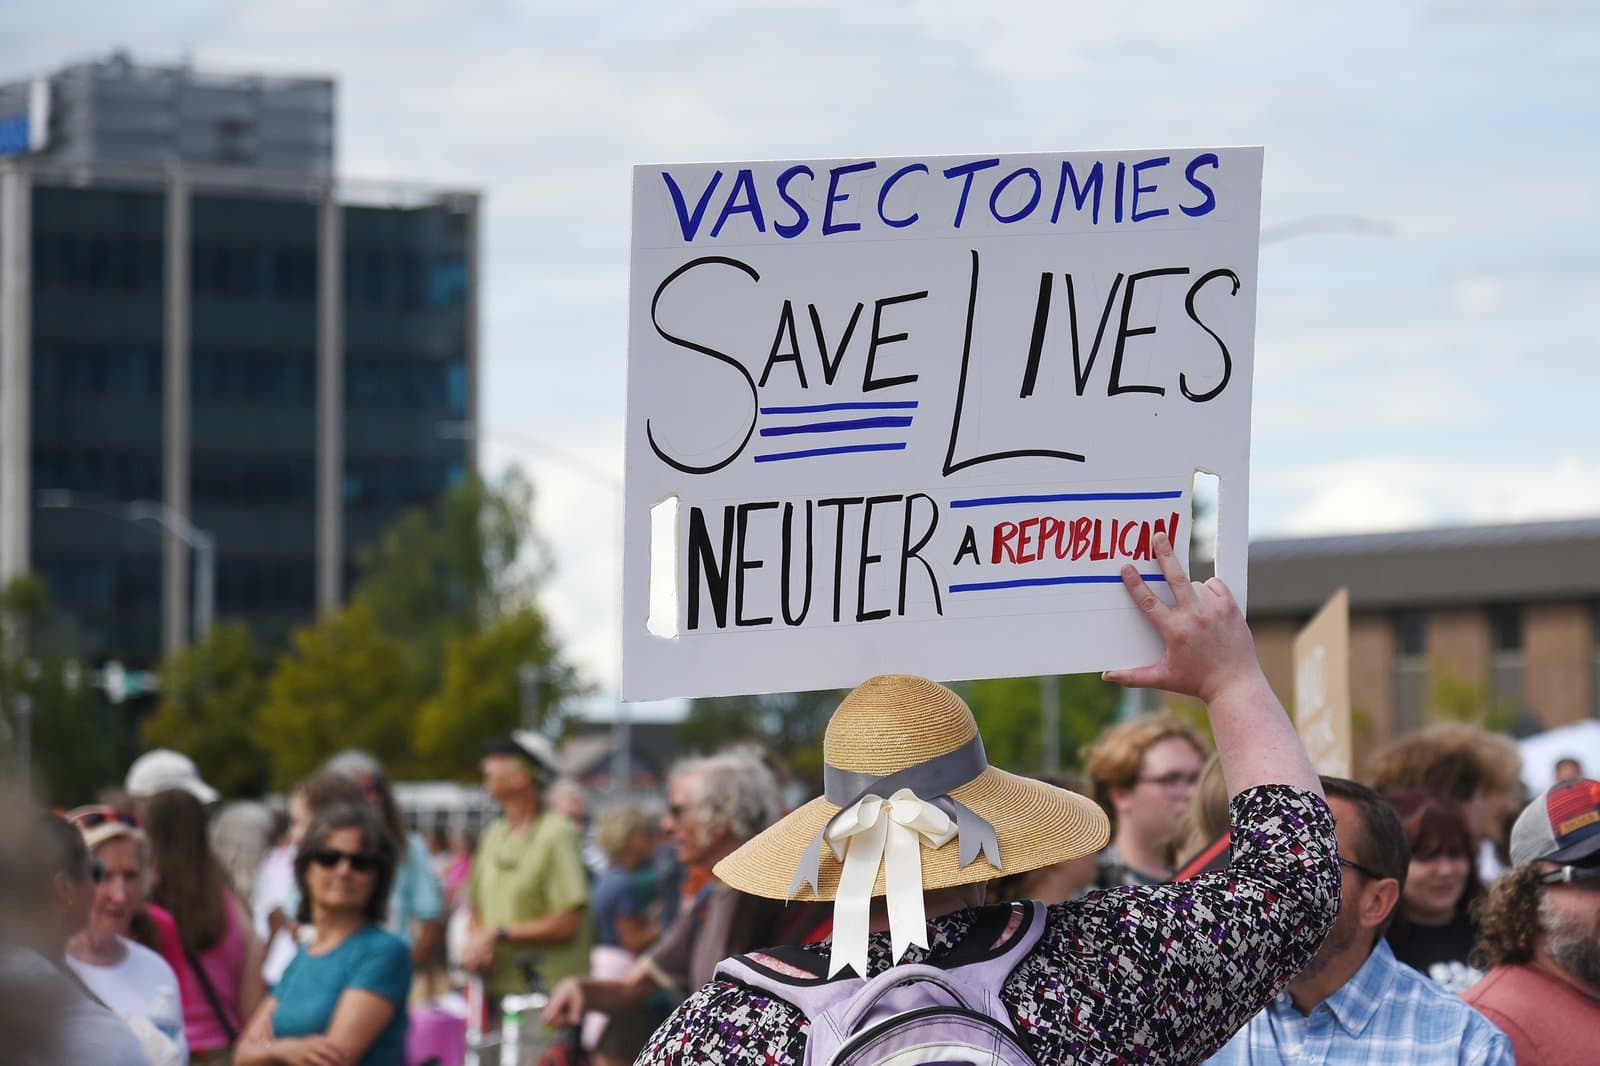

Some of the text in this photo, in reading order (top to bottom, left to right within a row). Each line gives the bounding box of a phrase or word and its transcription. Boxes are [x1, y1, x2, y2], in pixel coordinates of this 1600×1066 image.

[662, 153, 1220, 242] VASECTOMIES
[646, 249, 1241, 478] SAVE LIVES
[687, 493, 944, 630] NEUTER
[953, 525, 981, 566] A
